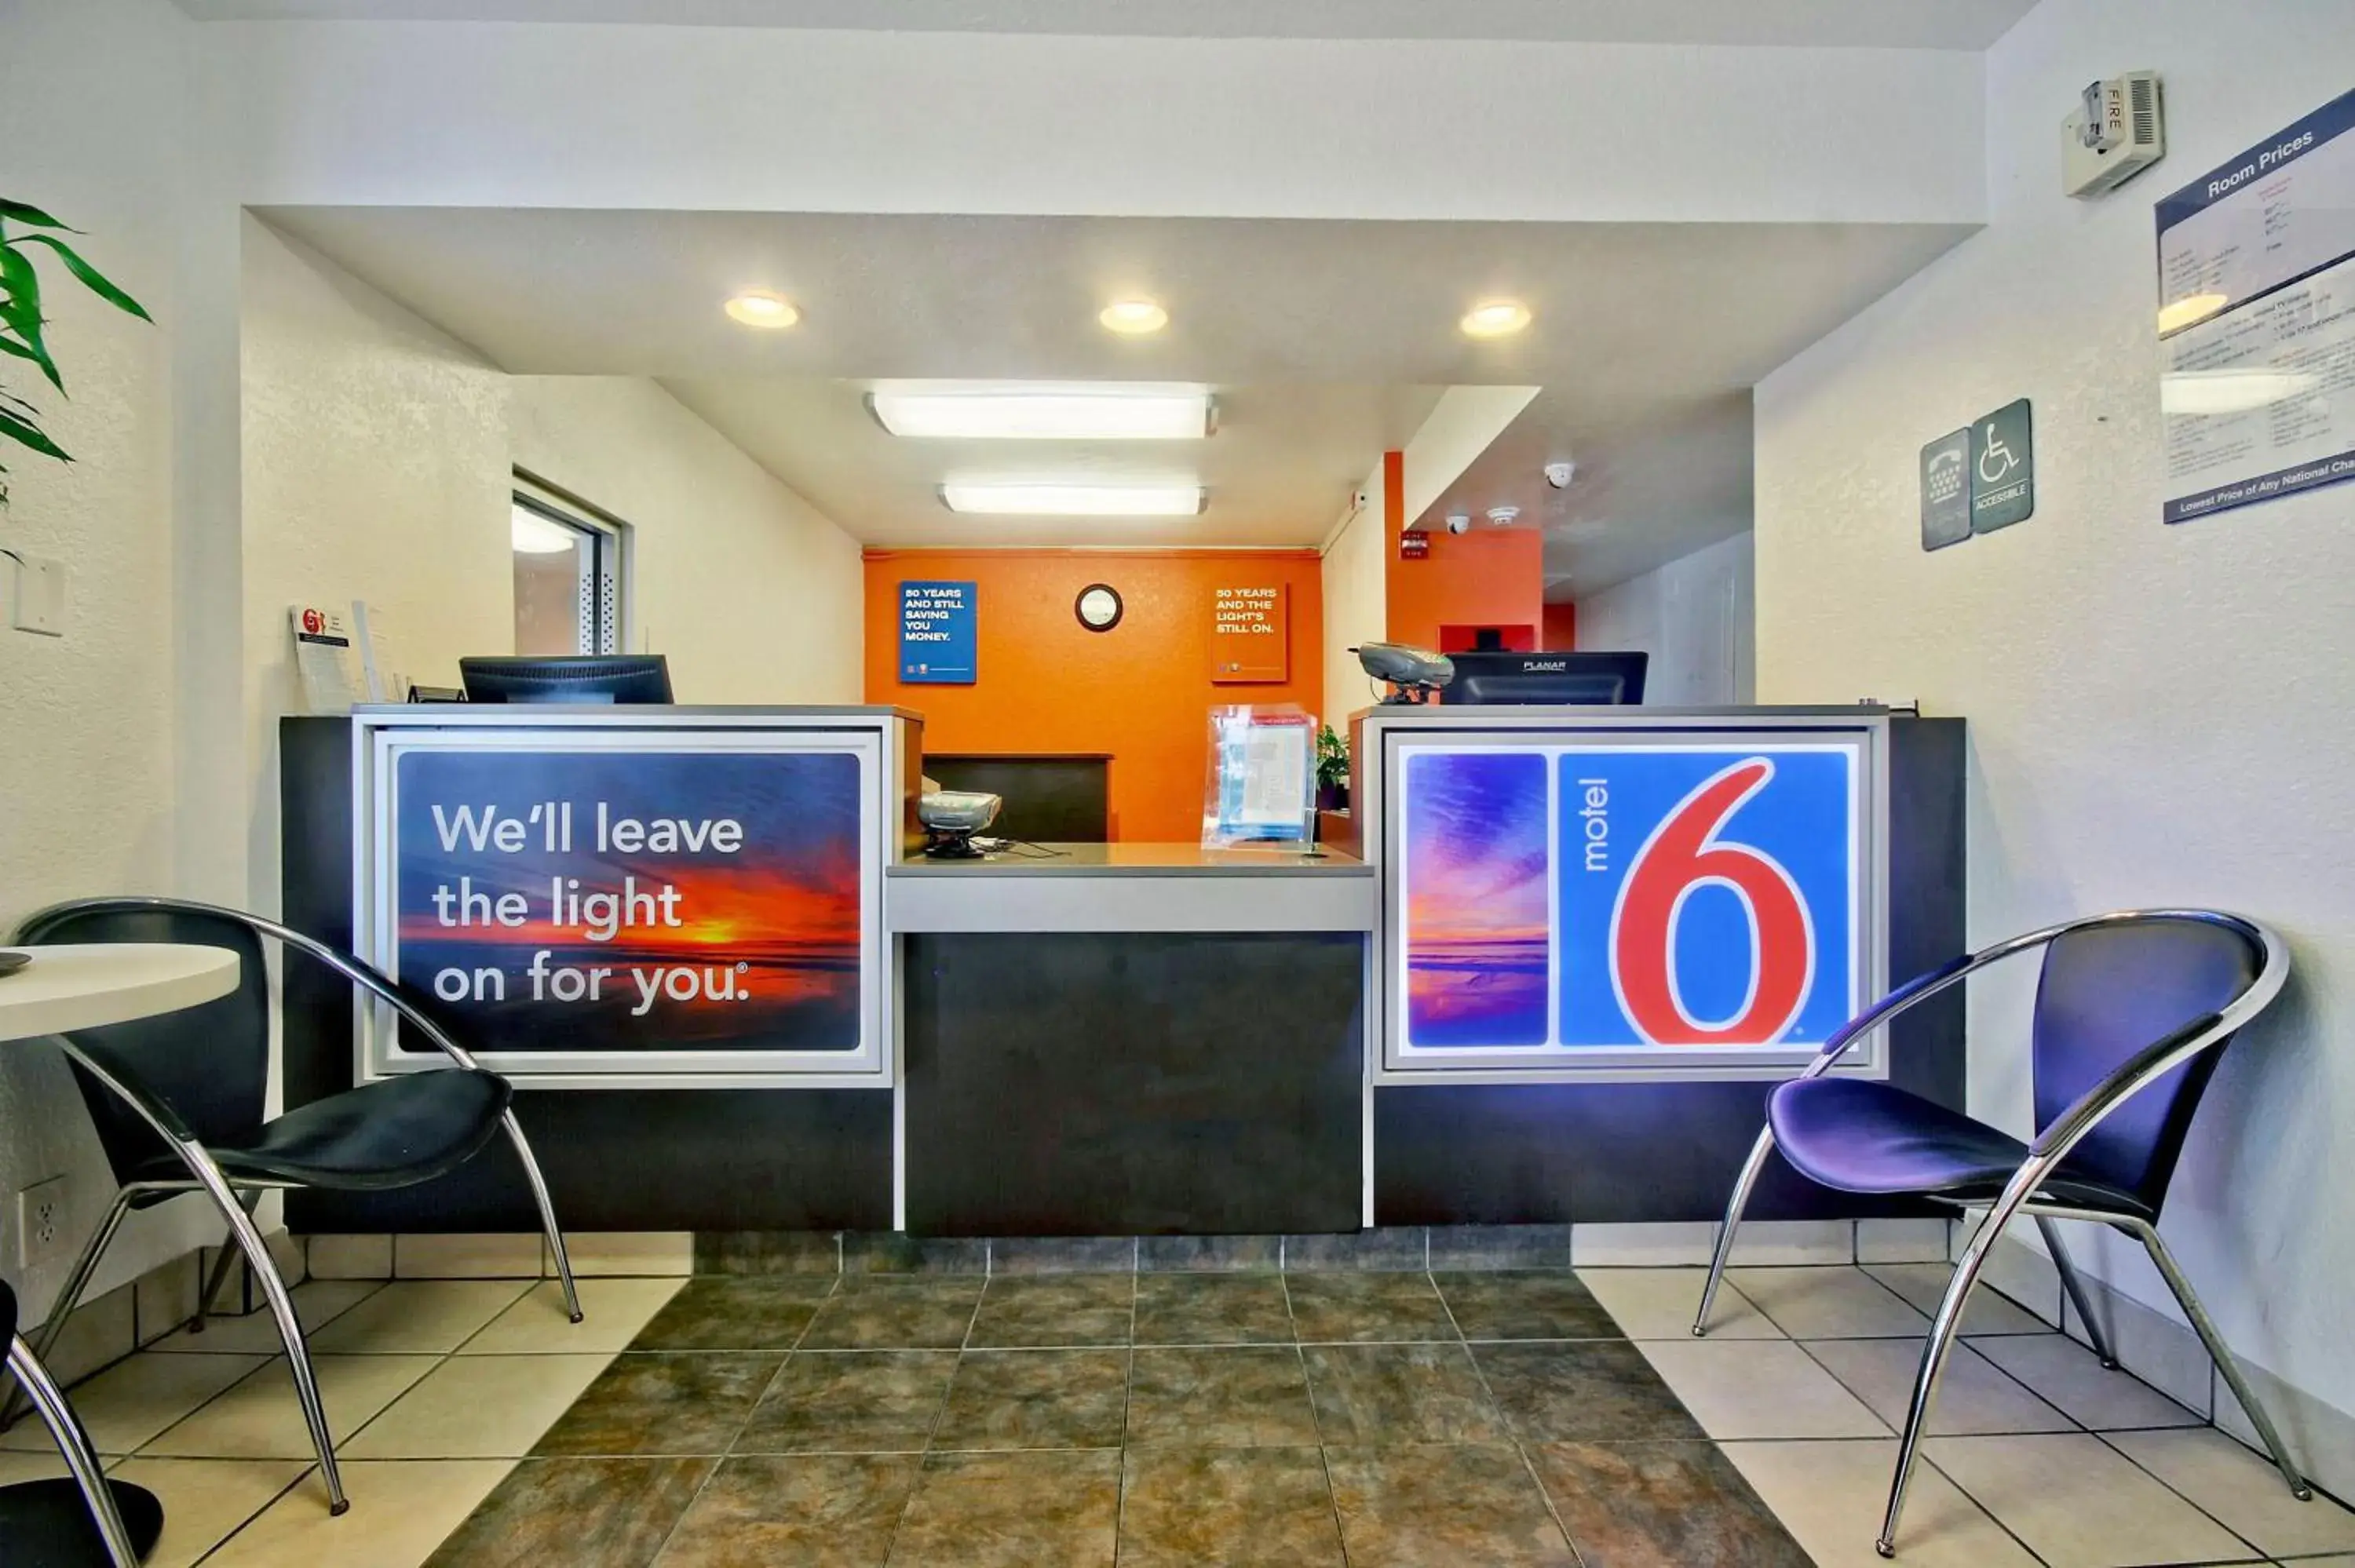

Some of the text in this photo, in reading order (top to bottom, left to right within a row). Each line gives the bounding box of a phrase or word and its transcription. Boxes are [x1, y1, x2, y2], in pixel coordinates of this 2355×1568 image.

[2109, 89, 2121, 129] FIRE
[2207, 163, 2255, 198] Room
[2258, 131, 2313, 170] Prices
[2180, 496, 2215, 512] Lowest
[2217, 487, 2243, 502] Price
[2245, 483, 2256, 495] of
[2258, 478, 2280, 494] Any
[2282, 463, 2329, 485] National
[905, 600, 964, 608] AND STILL
[1216, 600, 1272, 609] AND THE
[1234, 589, 1276, 597] YEARS
[905, 611, 949, 619] SAVING
[905, 622, 930, 630] YOU
[1216, 611, 1265, 621] LIGHT'S
[905, 633, 951, 641] MONEY.
[1216, 624, 1274, 633] STILL ON.
[432, 802, 743, 853] We'll leave
[1578, 779, 1608, 871] motel
[432, 877, 683, 943] the light
[1608, 756, 1816, 1046] 6
[433, 965, 505, 1001] on
[527, 950, 612, 1001] for
